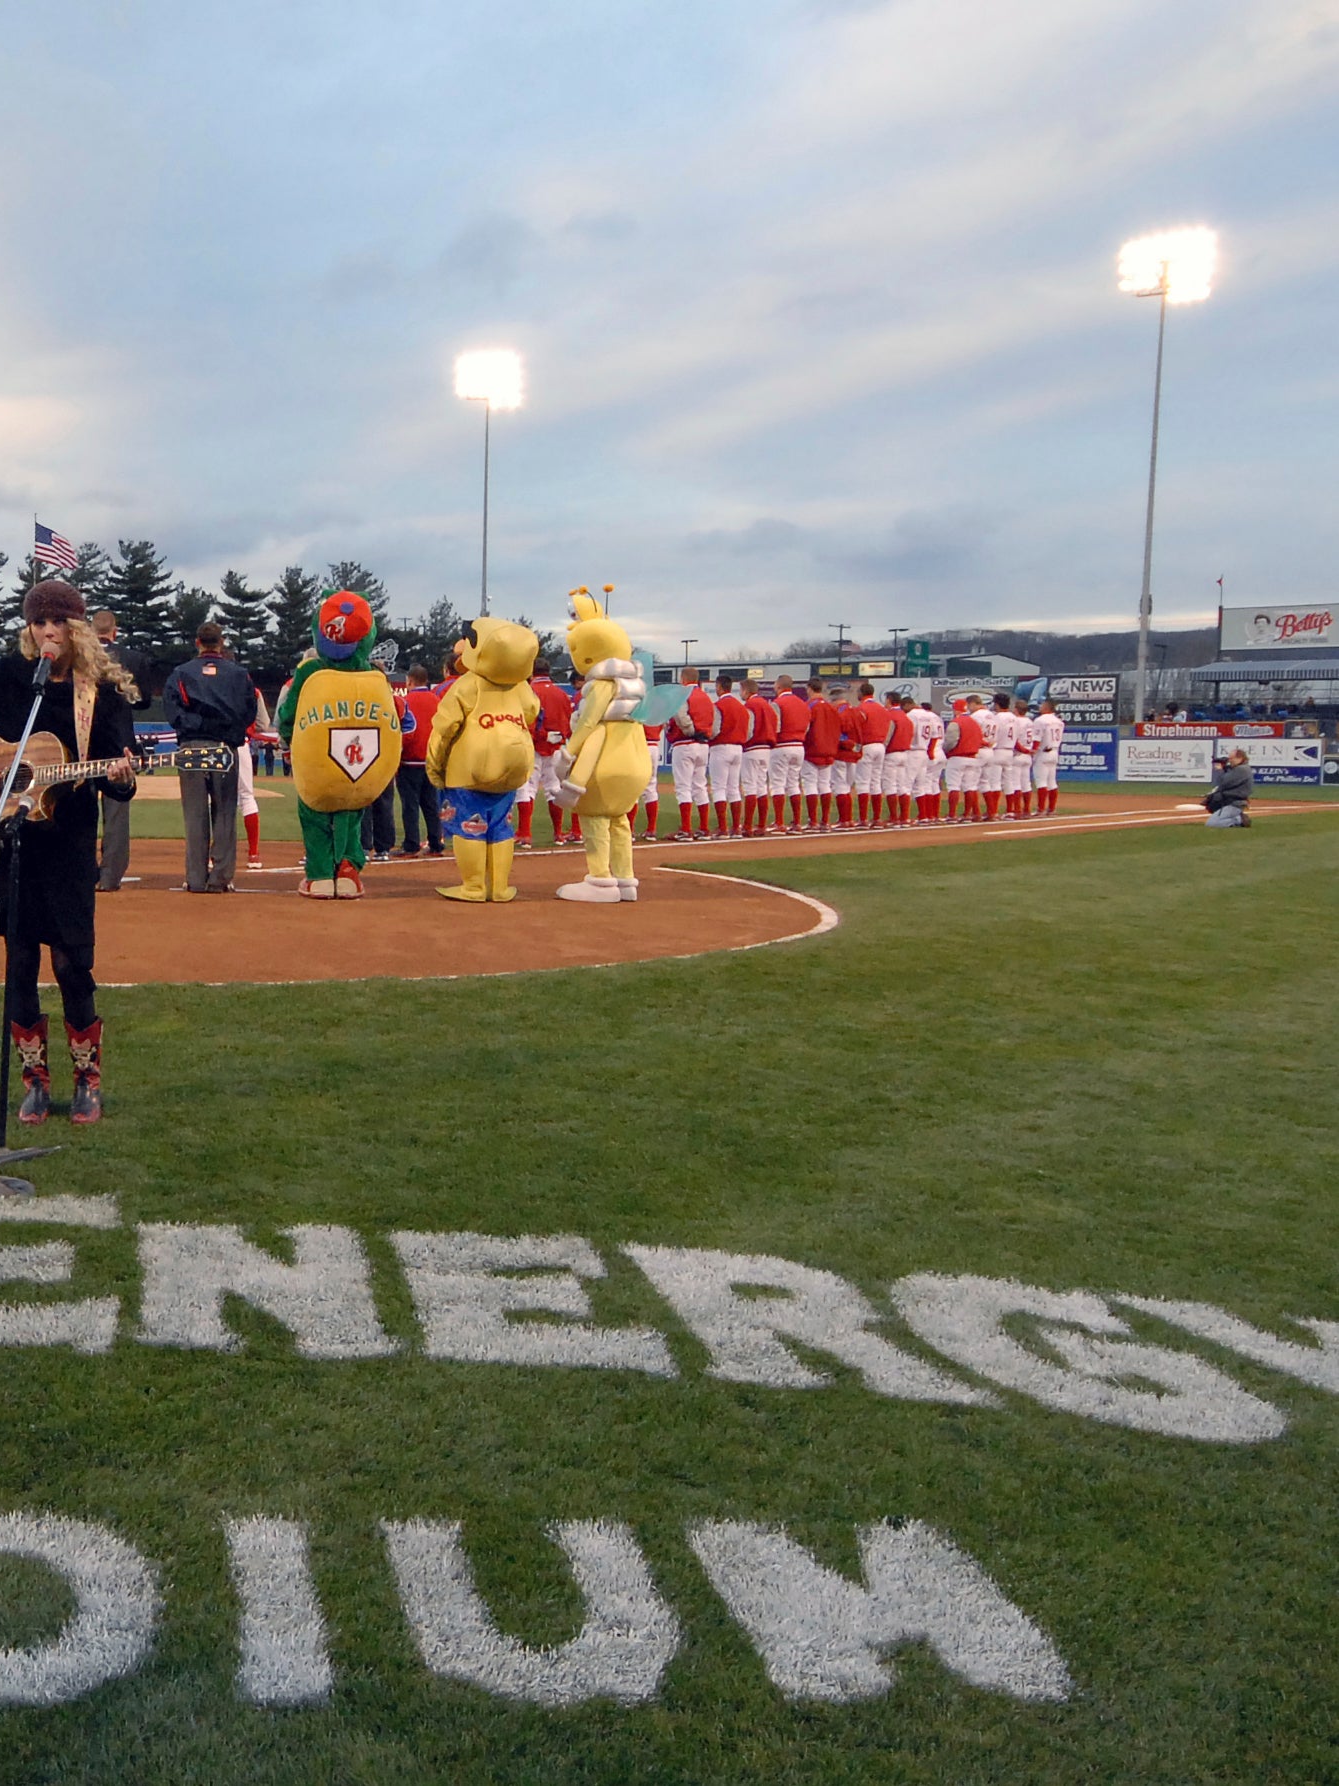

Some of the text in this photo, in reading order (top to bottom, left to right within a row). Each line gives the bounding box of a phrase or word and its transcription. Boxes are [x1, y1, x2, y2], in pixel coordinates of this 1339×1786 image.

[1071, 680, 1114, 692] NEWS
[1085, 712, 1113, 721] 10:30
[1127, 745, 1182, 762] Reading
